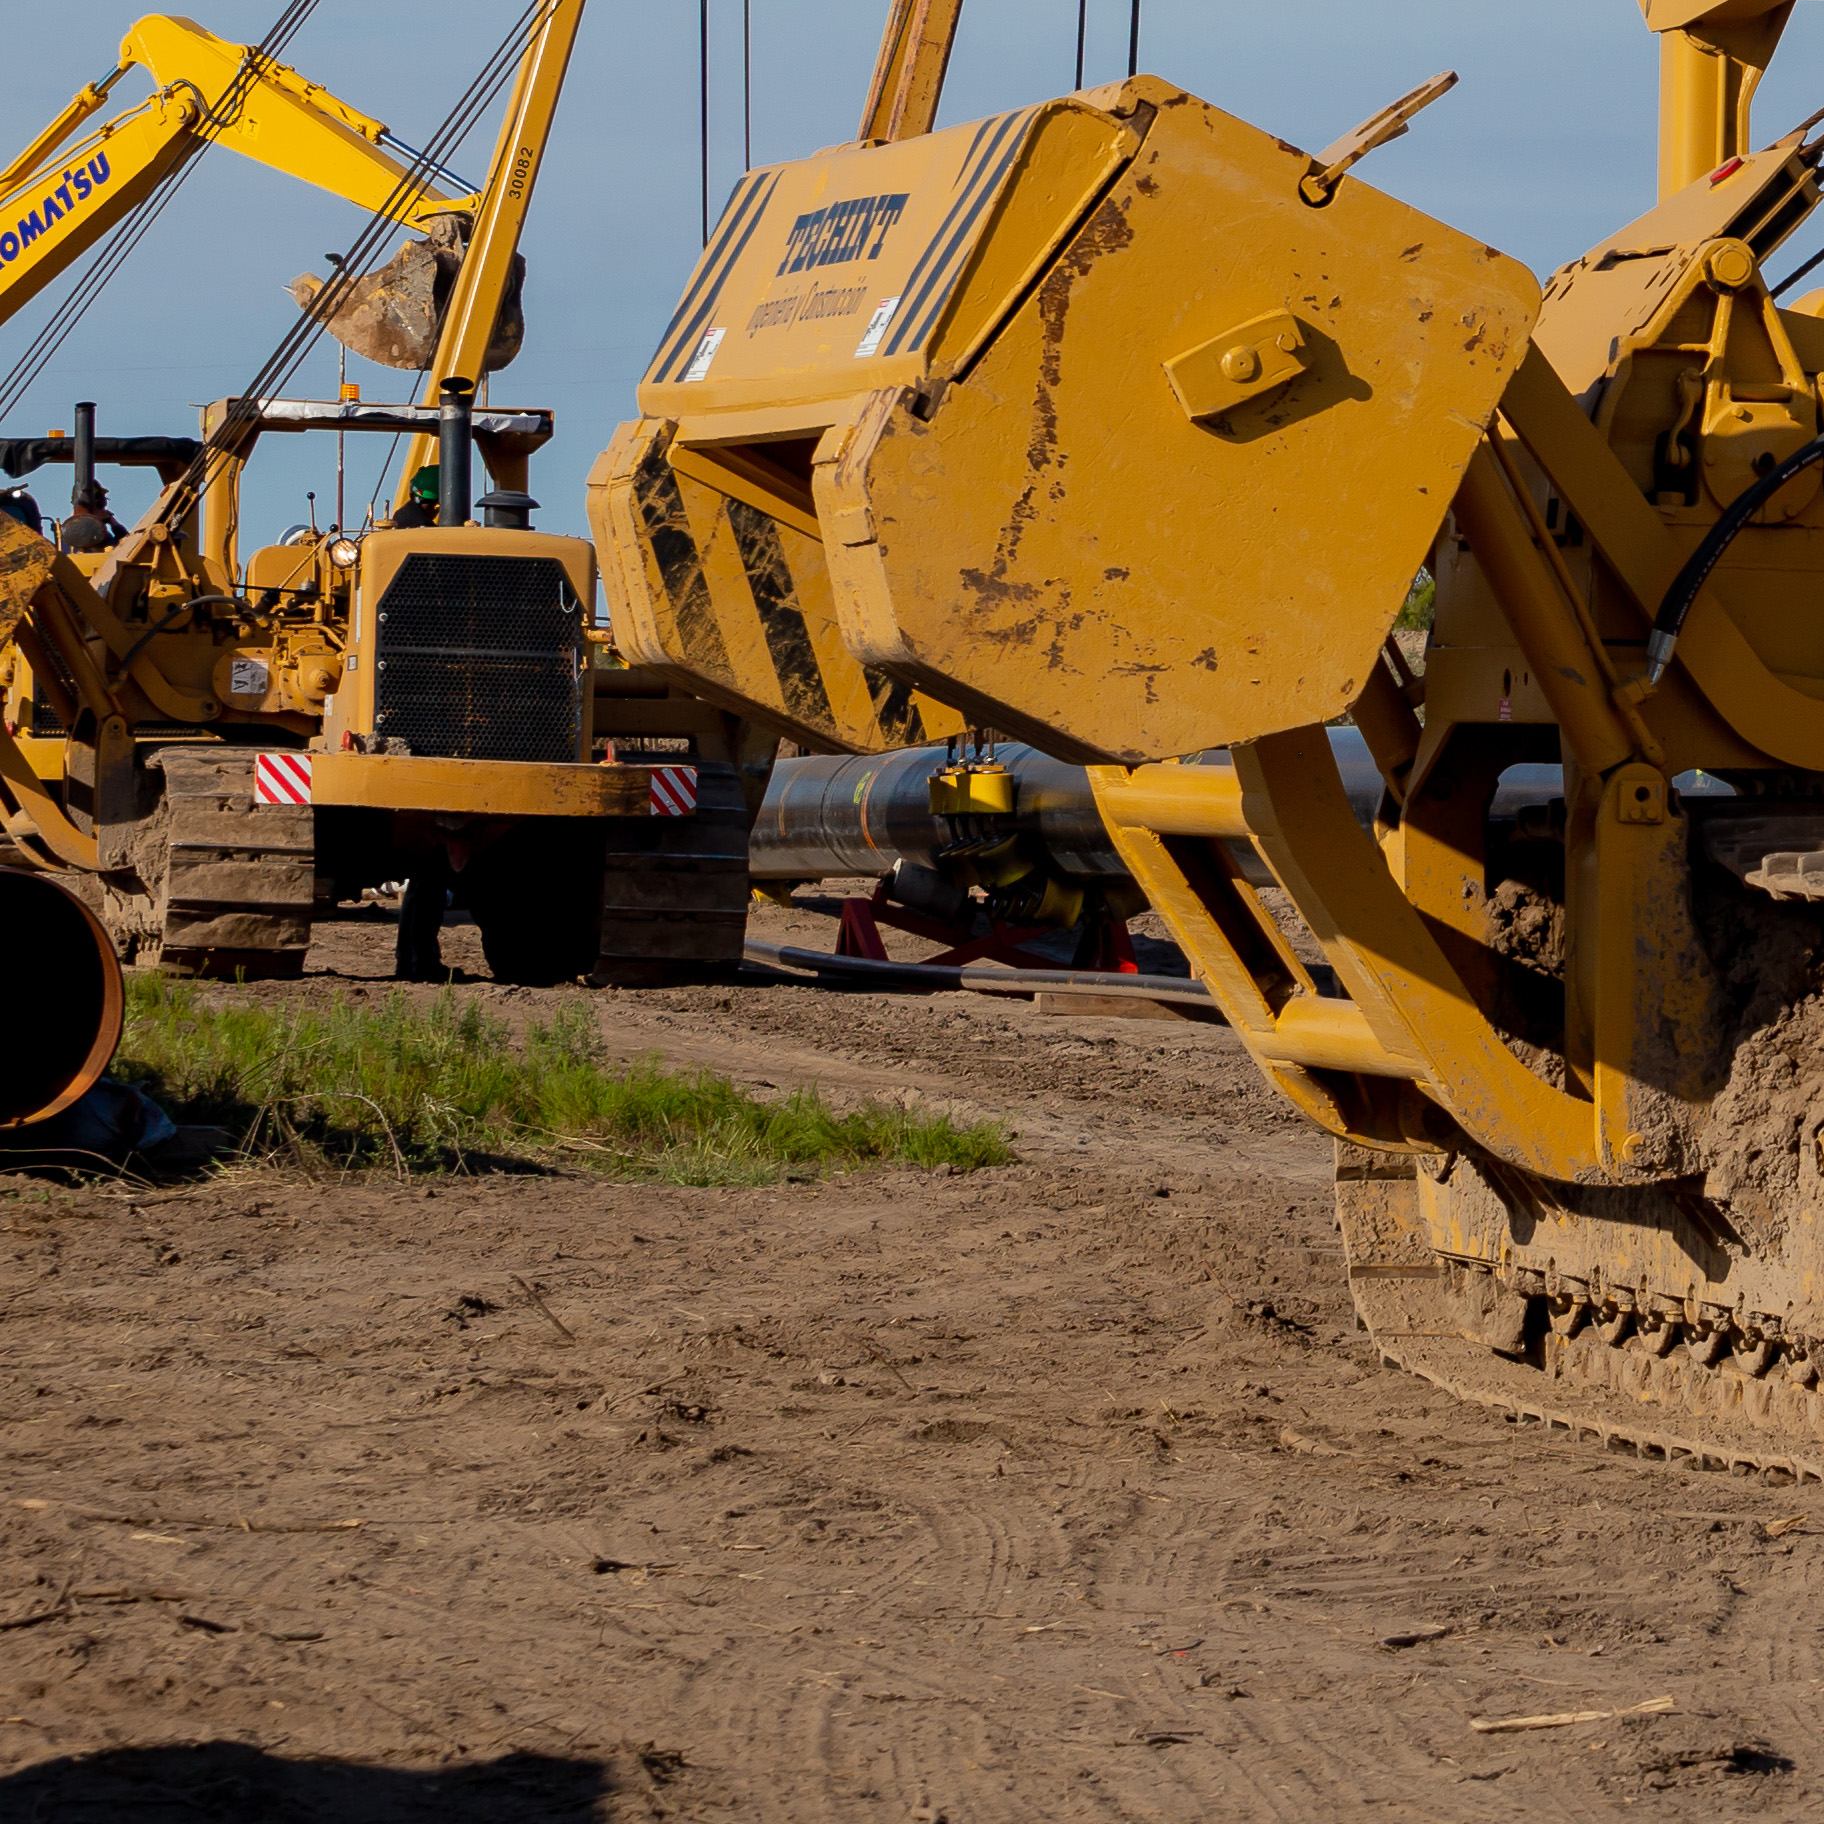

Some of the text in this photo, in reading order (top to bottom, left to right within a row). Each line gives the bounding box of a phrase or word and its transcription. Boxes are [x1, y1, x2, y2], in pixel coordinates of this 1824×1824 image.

[0, 150, 111, 271] OMATSU
[508, 146, 533, 200] 30082
[775, 193, 911, 278] TECHINT
